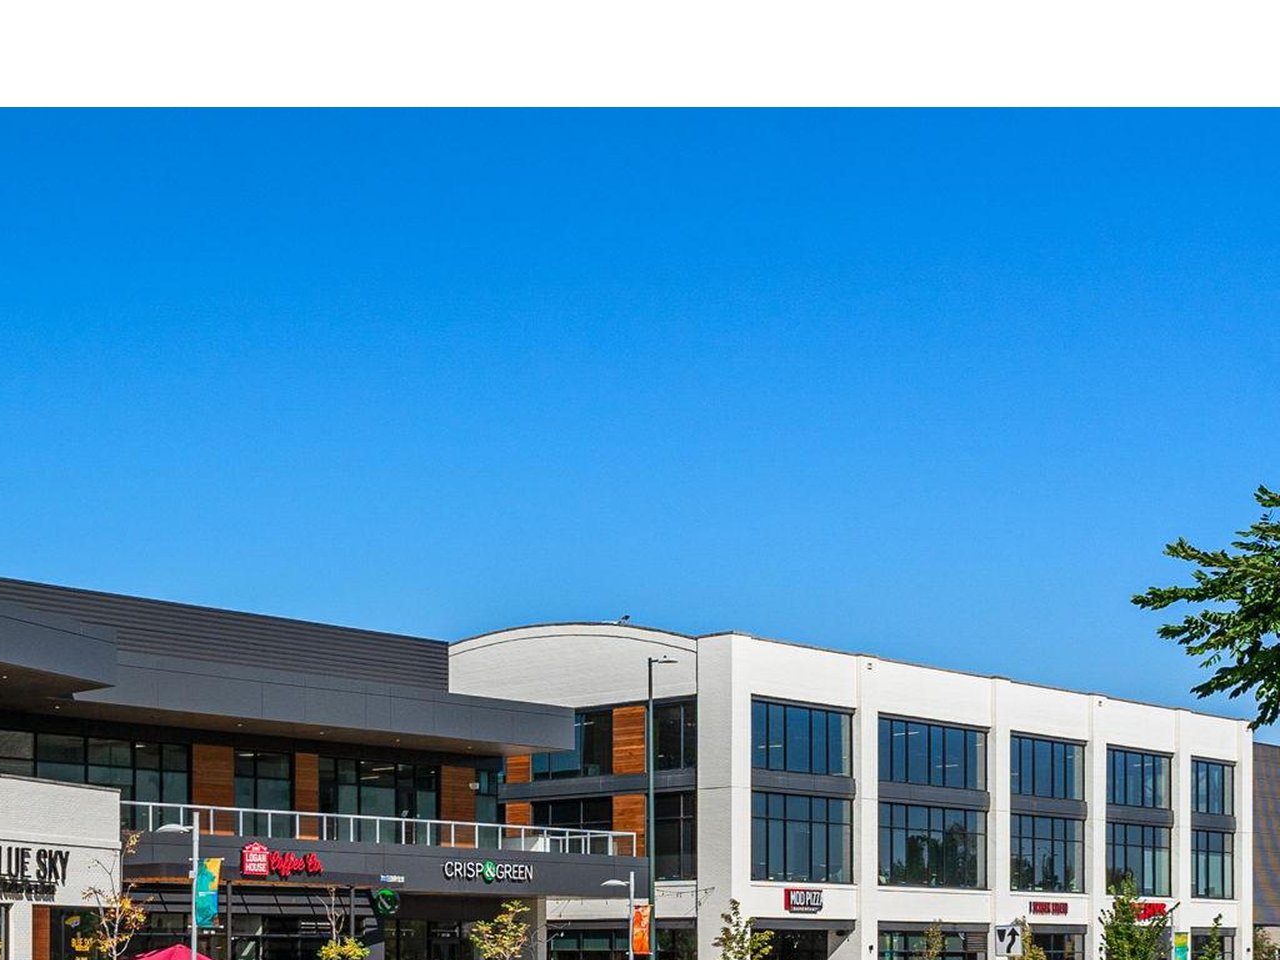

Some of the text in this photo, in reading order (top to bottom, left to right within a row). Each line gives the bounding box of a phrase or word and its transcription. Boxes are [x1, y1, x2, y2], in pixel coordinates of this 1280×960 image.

[36, 848, 70, 882] SKY
[245, 853, 267, 862] LOGAN
[269, 850, 306, 876] Coffee
[245, 863, 267, 872] HOUSE
[790, 890, 806, 906] MOD
